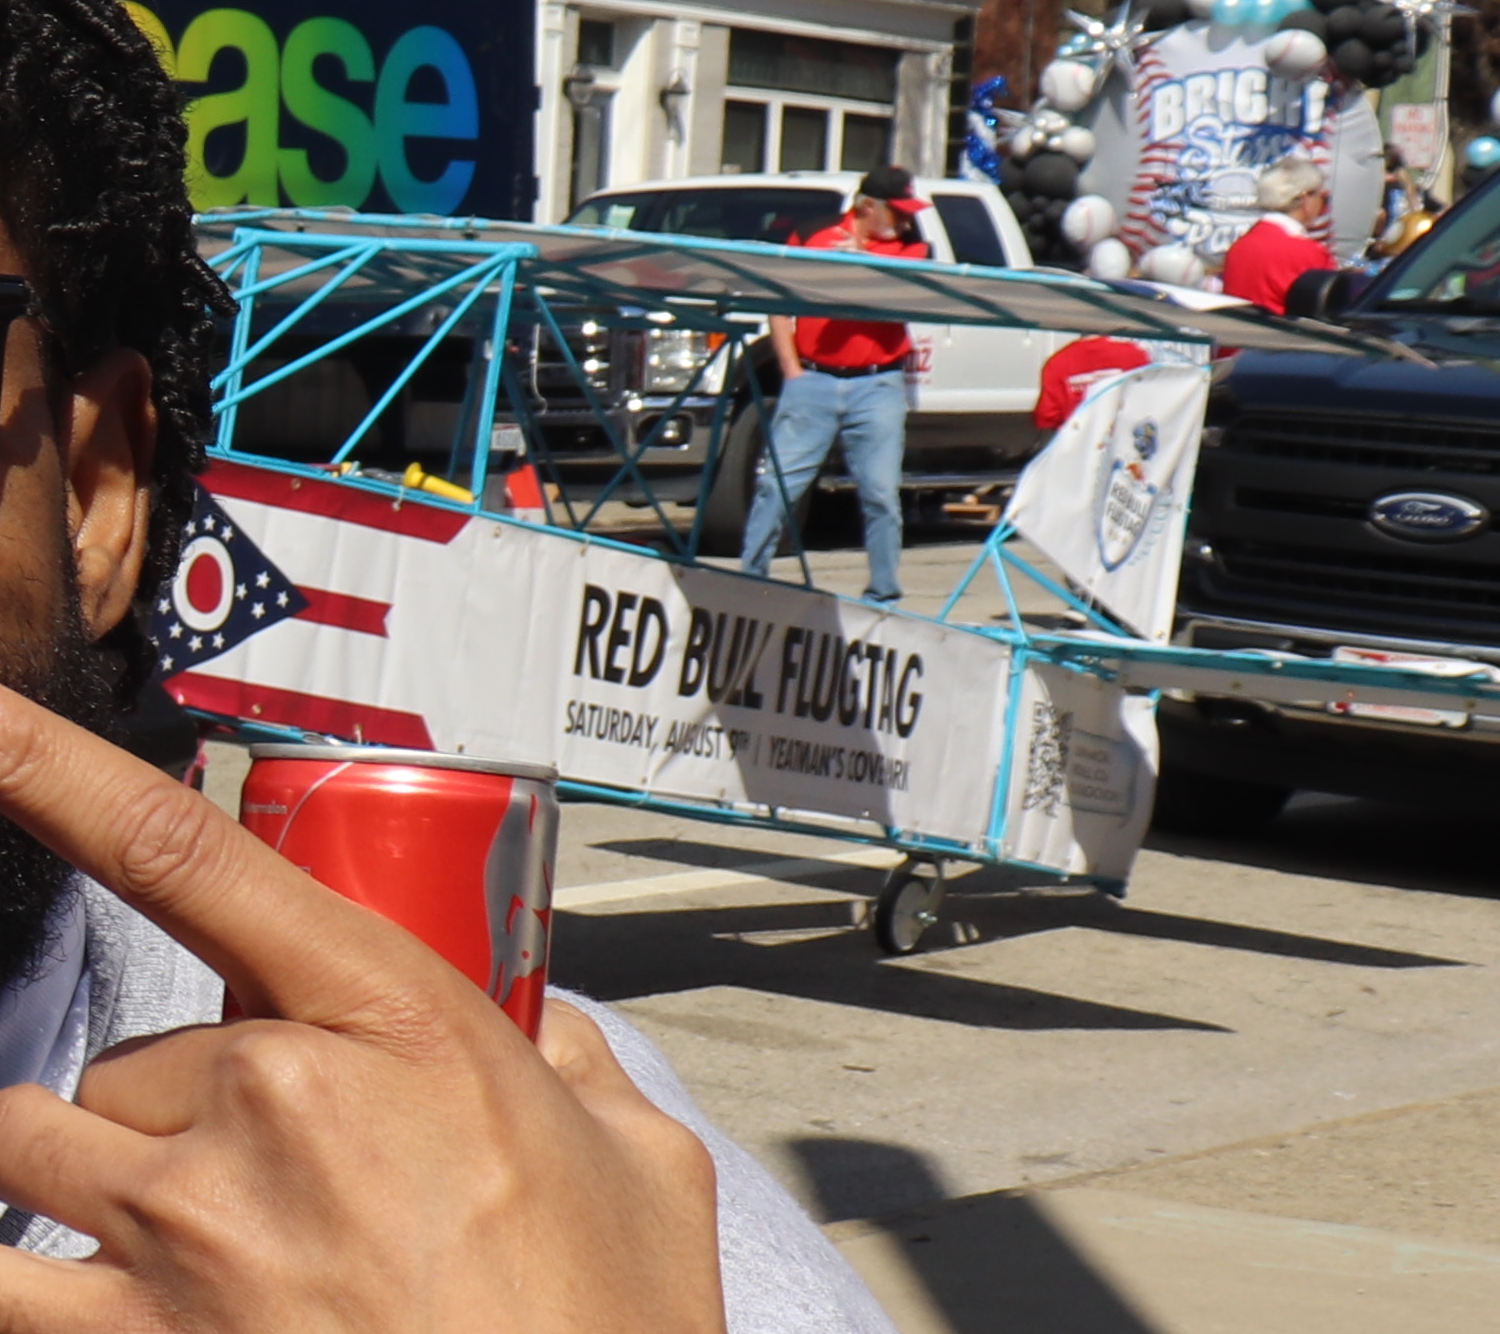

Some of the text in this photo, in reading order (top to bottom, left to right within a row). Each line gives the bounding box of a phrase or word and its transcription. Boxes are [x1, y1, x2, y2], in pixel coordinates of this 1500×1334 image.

[574, 583, 924, 739] RED BULL FLUGTAG
[565, 700, 660, 750] SATURDAY,
[664, 719, 724, 759] AUGUST
